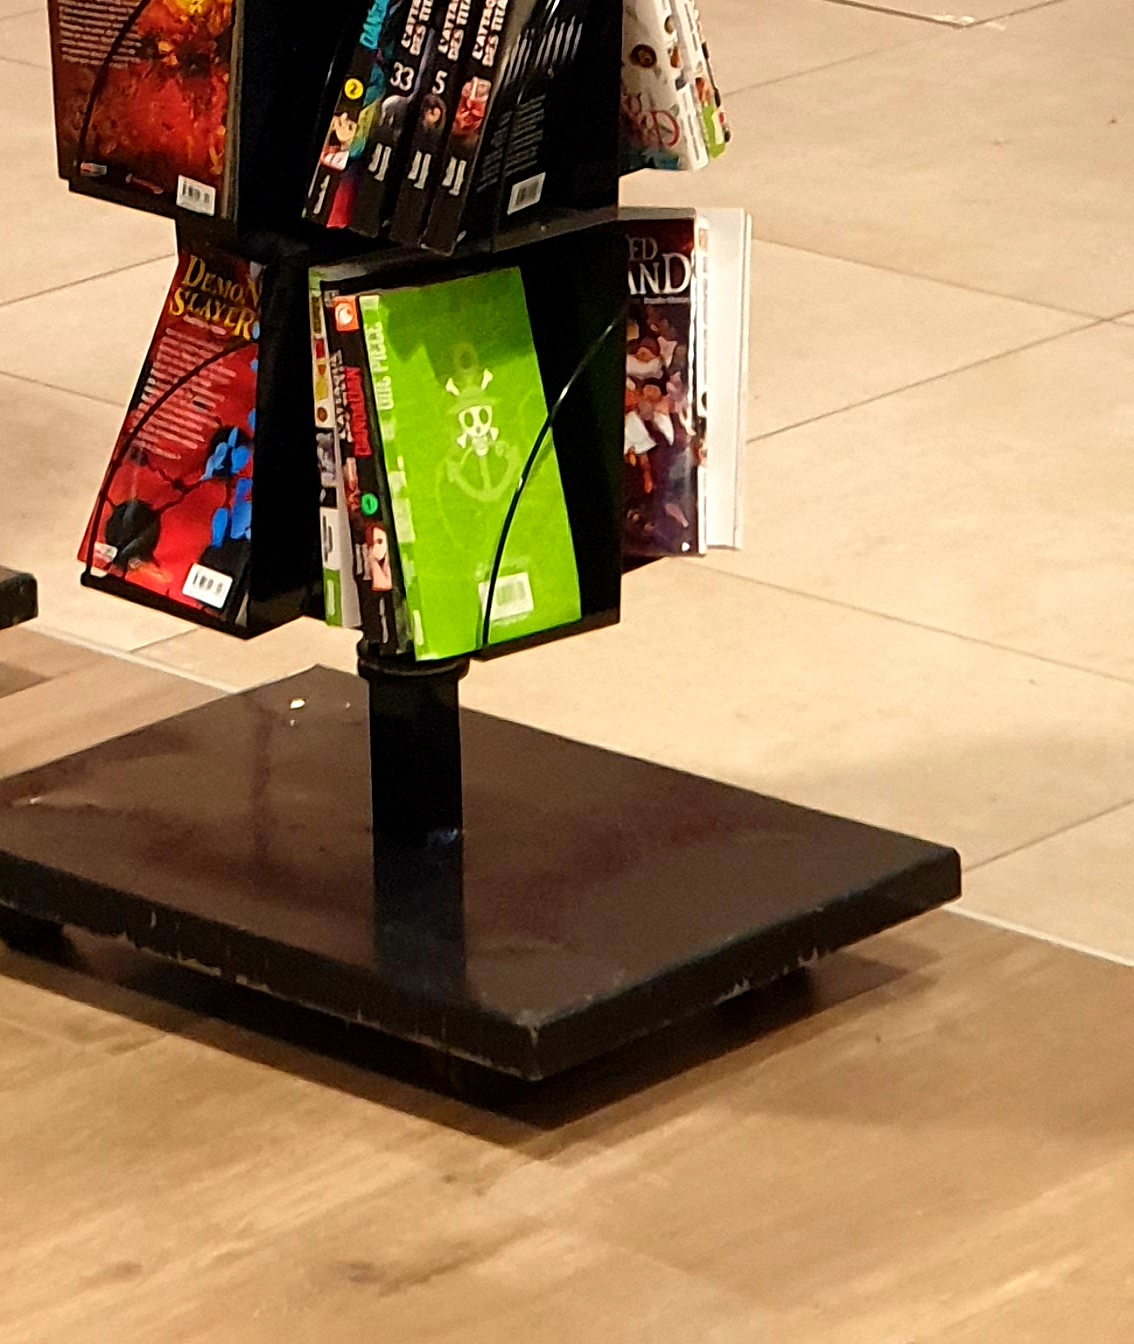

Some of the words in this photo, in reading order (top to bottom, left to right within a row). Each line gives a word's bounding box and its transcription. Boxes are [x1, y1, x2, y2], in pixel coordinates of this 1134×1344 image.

[390, 61, 415, 92] 33
[409, 24, 427, 56] DES
[431, 69, 448, 95] 5
[447, 29, 464, 61] DES
[482, 34, 499, 67] DES
[181, 255, 259, 308] DEMON
[169, 286, 256, 341] SLAYER
